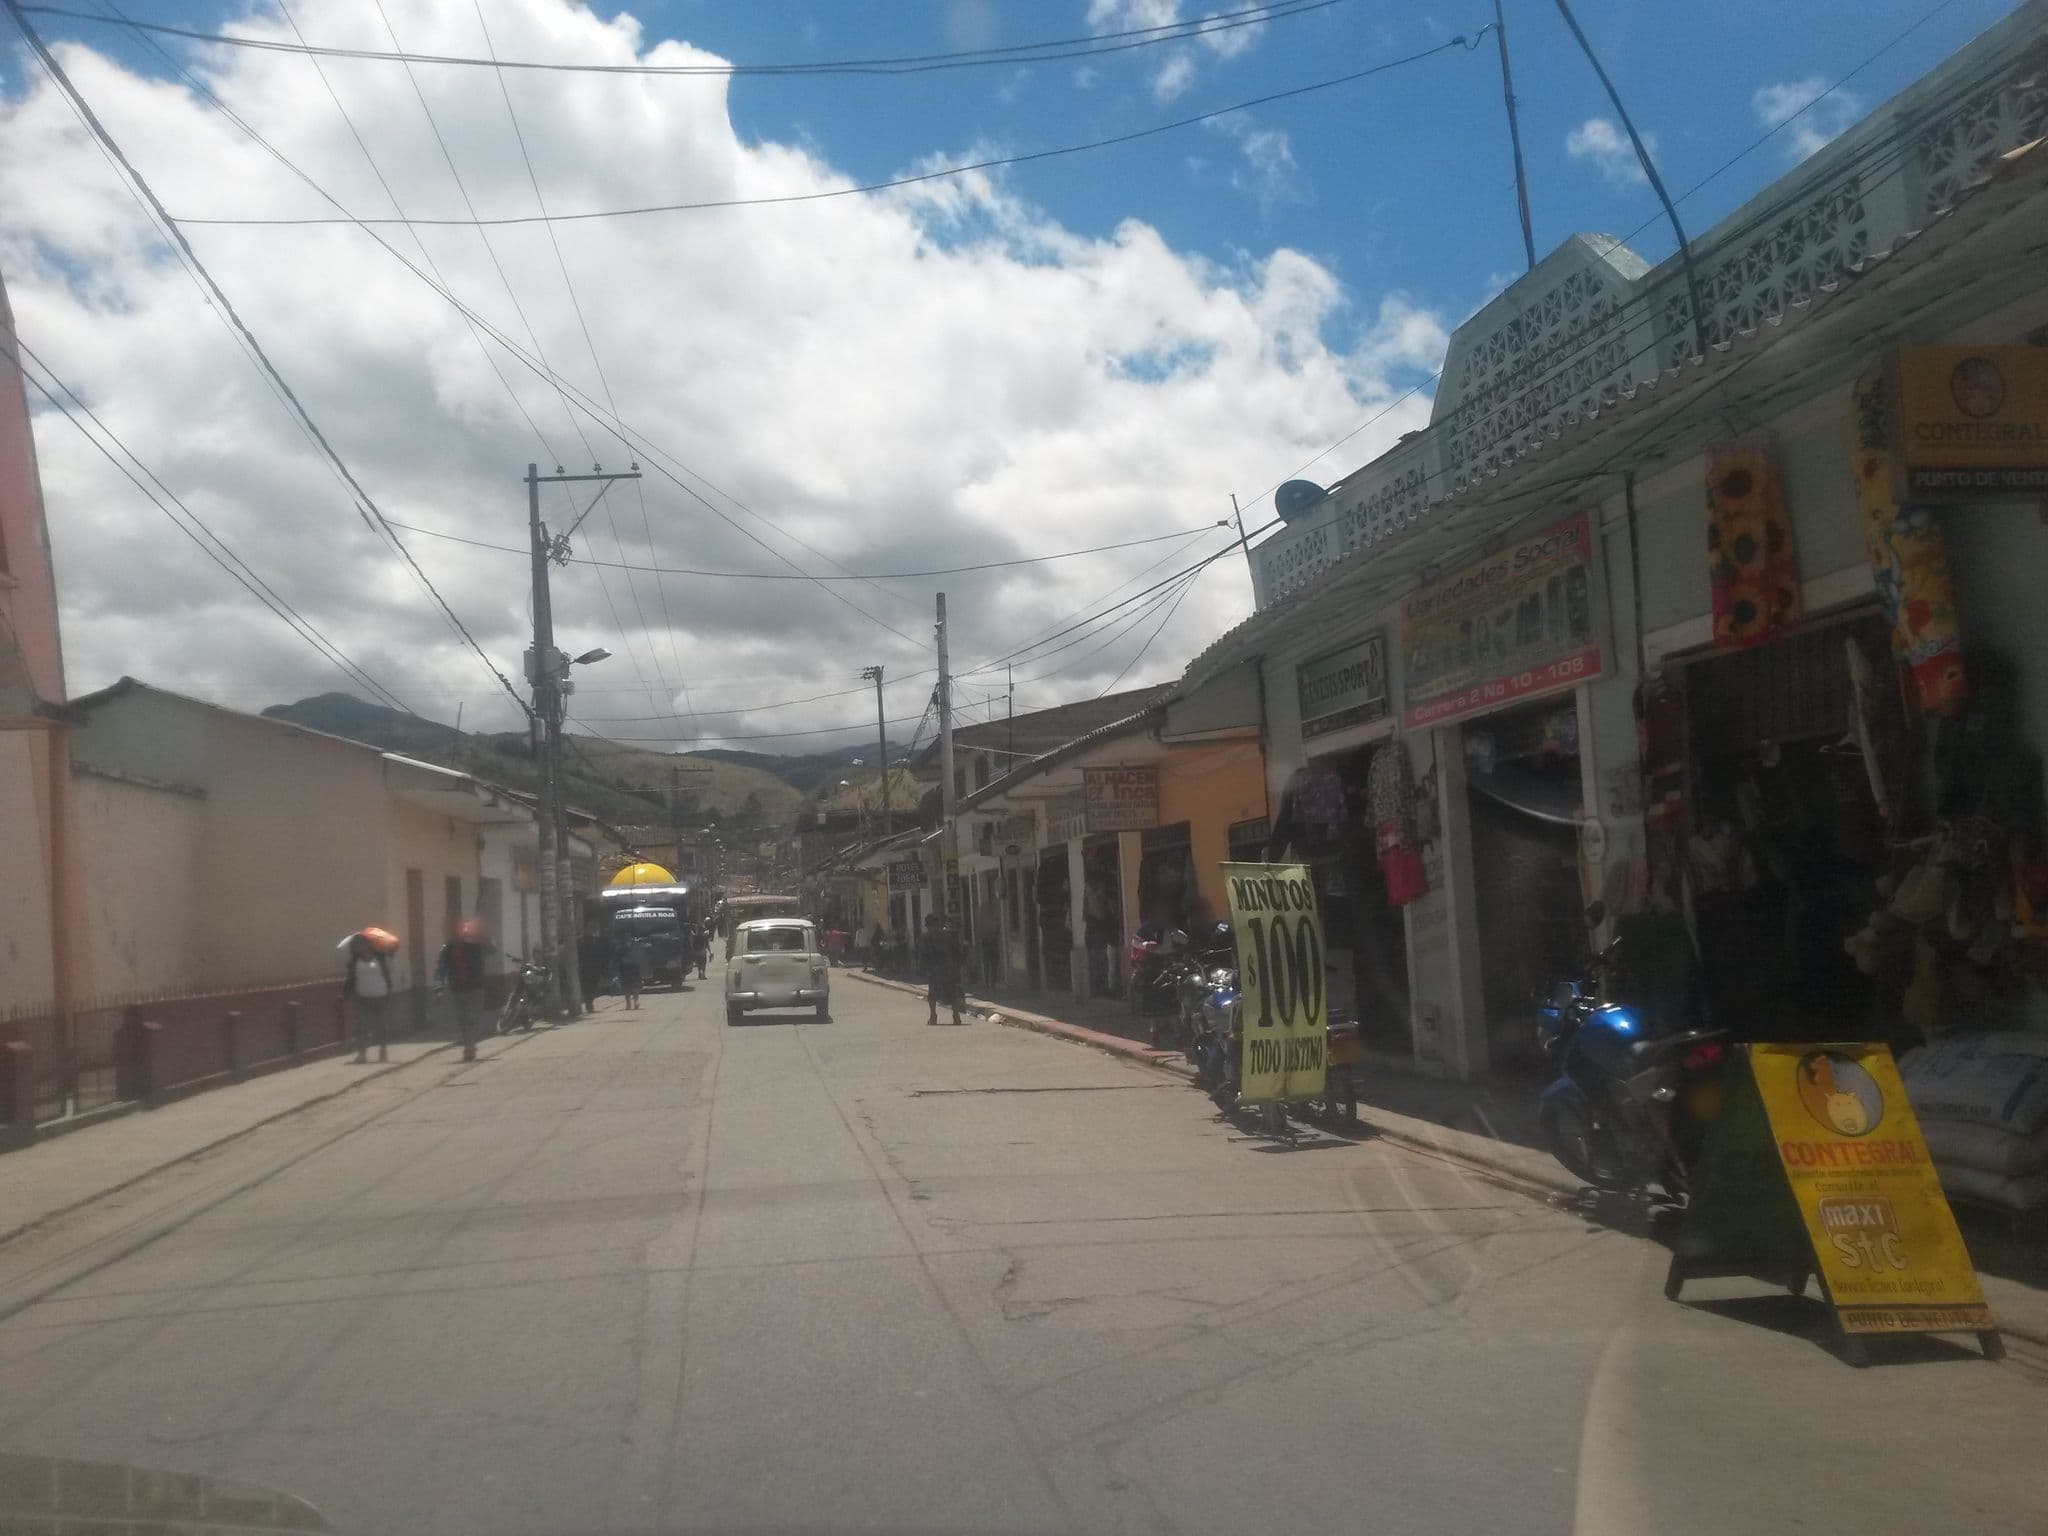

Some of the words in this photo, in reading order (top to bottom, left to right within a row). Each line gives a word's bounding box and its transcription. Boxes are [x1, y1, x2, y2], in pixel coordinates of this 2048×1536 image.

[1915, 422, 2047, 442] CONTEGRAL
[1470, 690, 1481, 703] 2
[1511, 674, 1533, 688] 10
[1232, 879, 1314, 911] MINUTOS
[1249, 1038, 1282, 1075] TODO
[1283, 1035, 1323, 1073] DESTINO
[1782, 1140, 1926, 1167] CONTEGRAL
[1824, 1203, 1884, 1227] maxi
